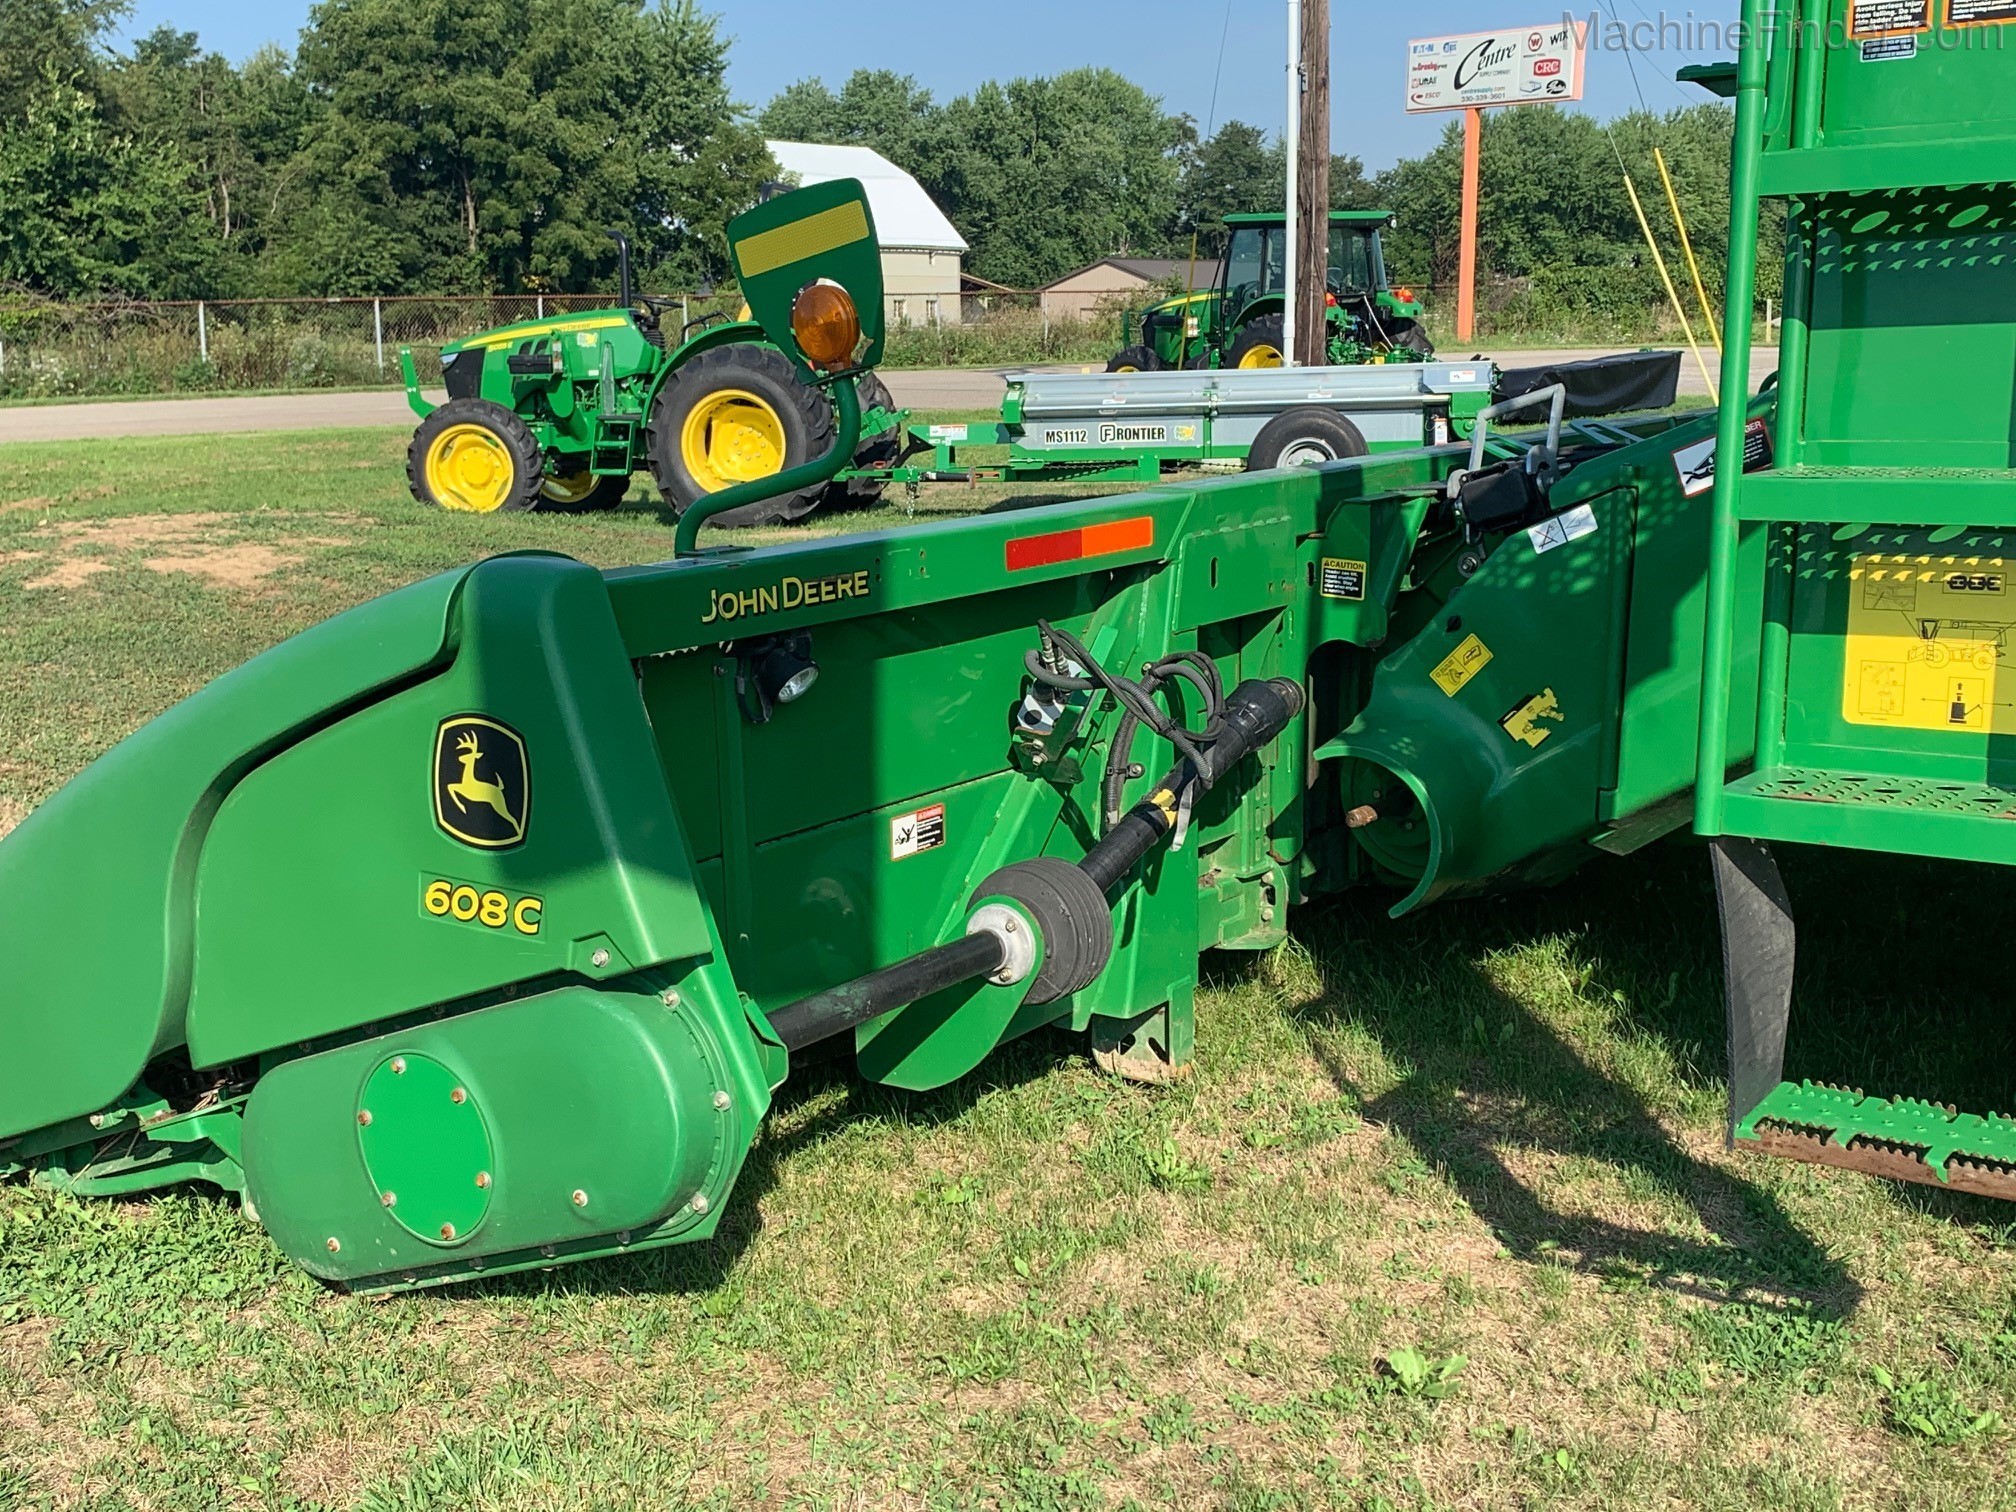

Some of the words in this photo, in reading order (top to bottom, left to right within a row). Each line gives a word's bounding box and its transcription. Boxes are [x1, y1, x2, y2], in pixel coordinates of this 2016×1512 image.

[1856, 5, 1876, 13] Avoid
[1877, 2, 1904, 11] serious
[1905, 0, 1926, 9] injury
[1870, 16, 1892, 24] ladder
[1550, 29, 1569, 46] WIX
[1454, 38, 1516, 90] Centre
[1534, 60, 1559, 74] CRC
[1461, 86, 1506, 95] centresupply.com
[1045, 429, 1088, 444] MS1112
[1100, 424, 1166, 442] FRONTIER
[1330, 560, 1364, 570] CAUTION
[701, 585, 779, 623] JOHN
[781, 570, 870, 609] DEERE
